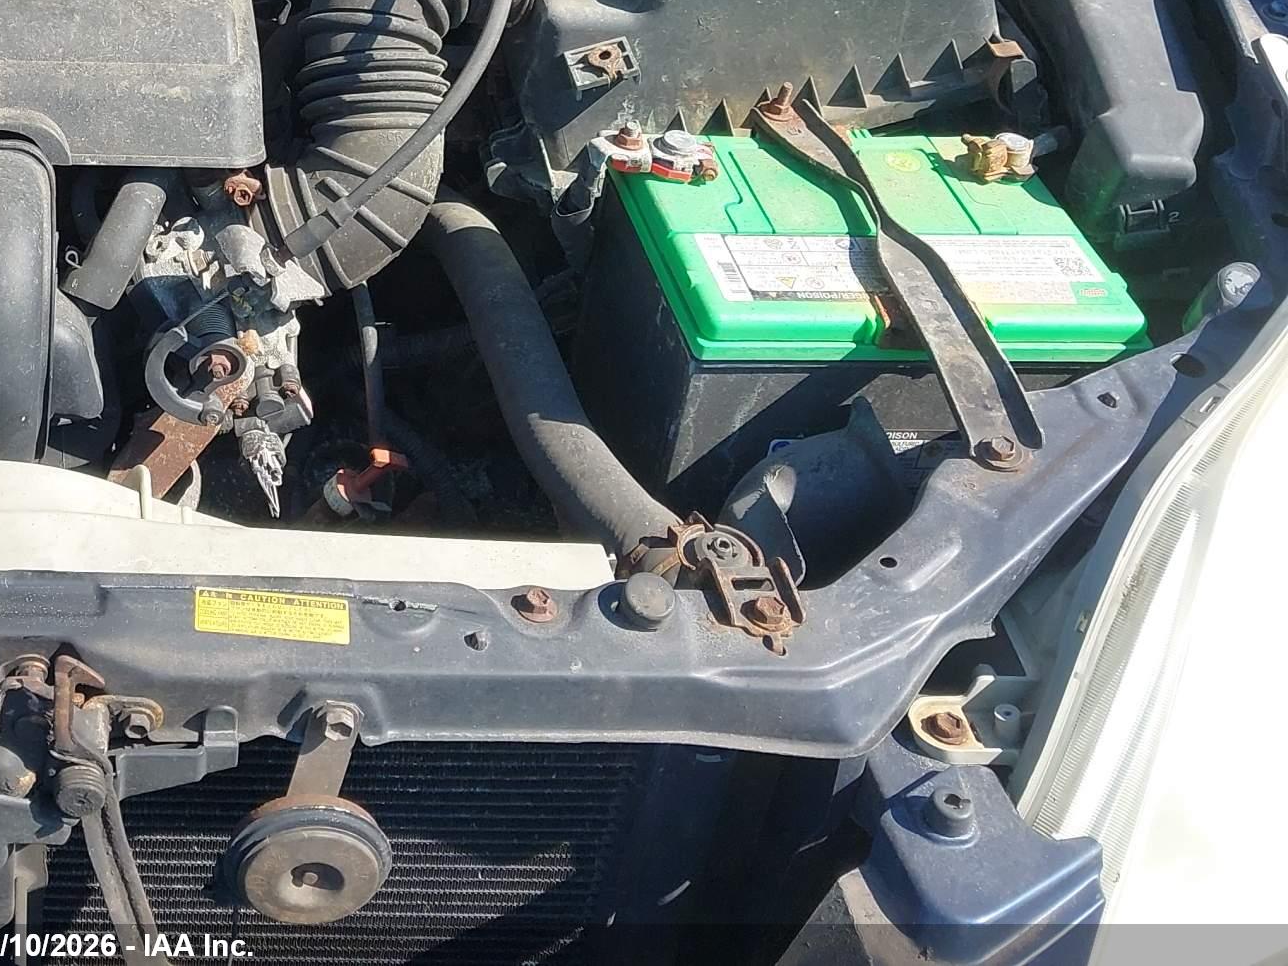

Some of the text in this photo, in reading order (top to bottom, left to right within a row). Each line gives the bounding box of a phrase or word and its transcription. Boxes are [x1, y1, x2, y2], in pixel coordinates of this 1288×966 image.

[885, 431, 918, 440] OISON
[240, 594, 286, 605] CAUTION
[293, 600, 344, 610] ATTENTION
